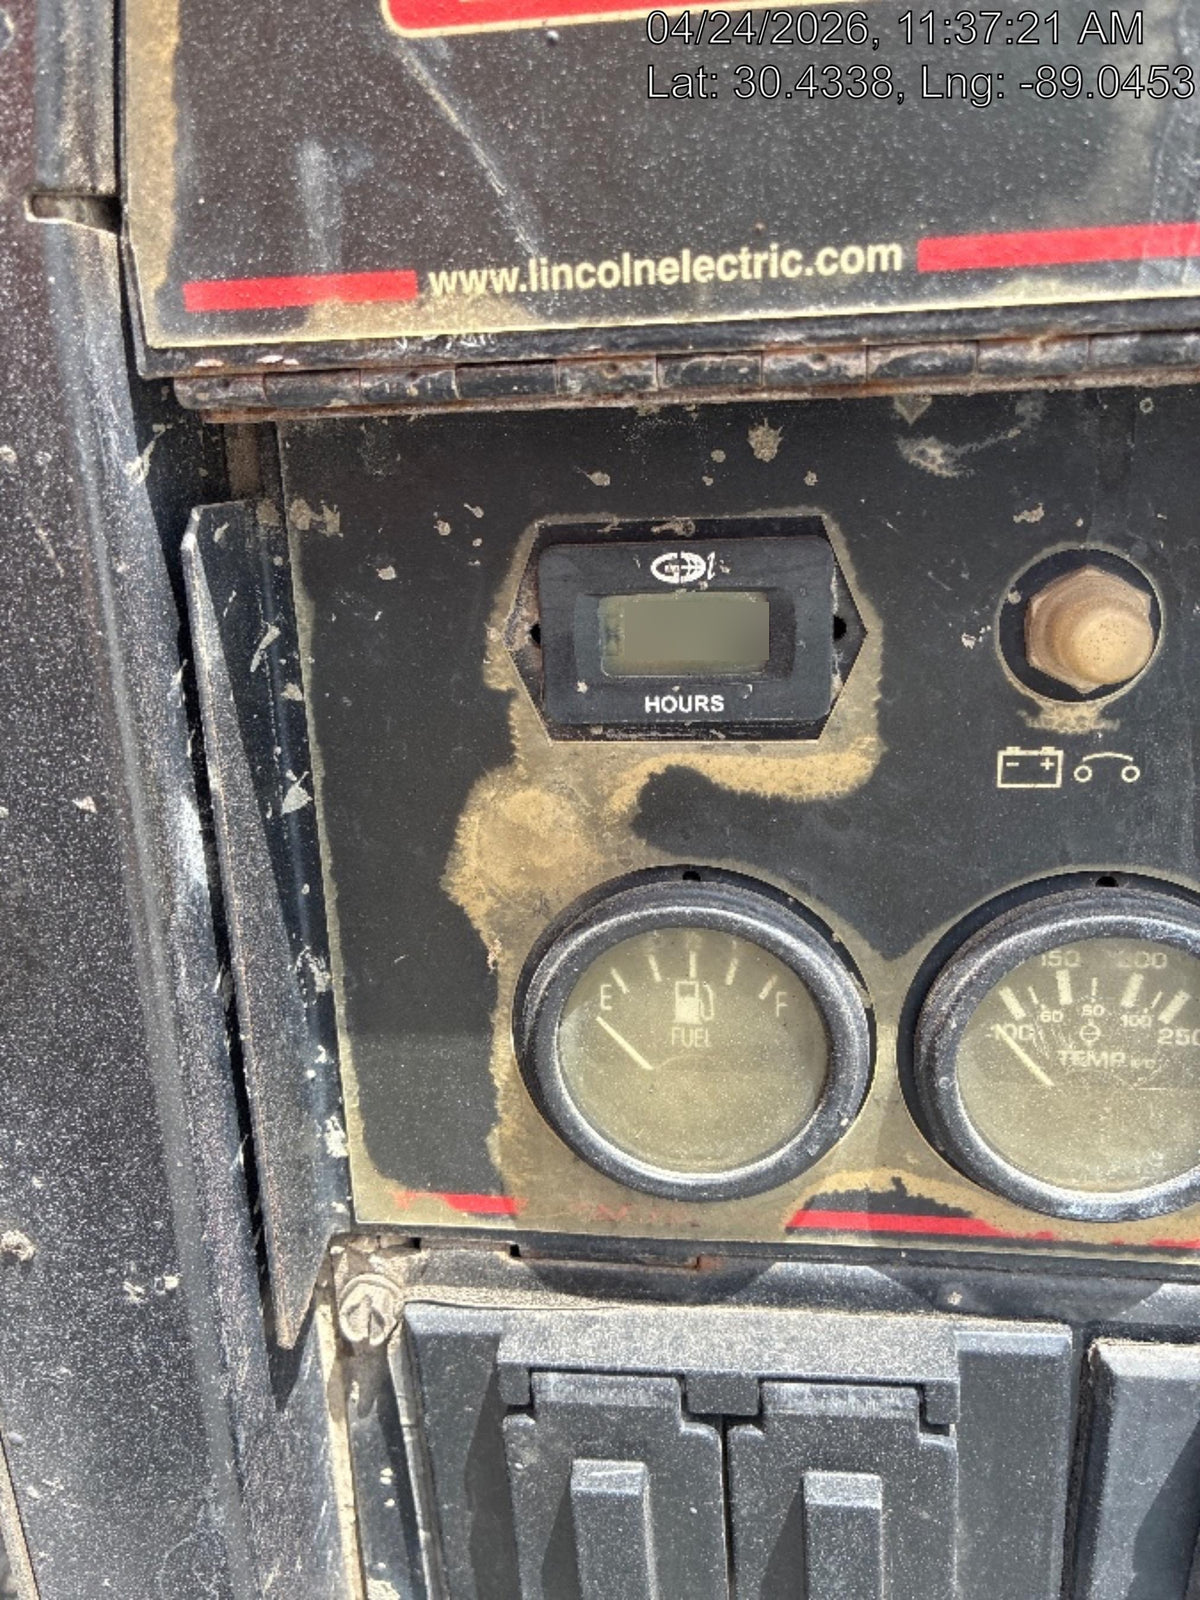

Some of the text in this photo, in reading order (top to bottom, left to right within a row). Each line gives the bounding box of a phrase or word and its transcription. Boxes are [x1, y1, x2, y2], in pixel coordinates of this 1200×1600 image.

[428, 242, 903, 297] www.lincolnelectric.com
[644, 694, 725, 714] HOURS
[1040, 950, 1081, 968] 150
[600, 984, 613, 1011] E
[775, 991, 788, 1017] F
[671, 1028, 712, 1048] FUEL
[1057, 1050, 1126, 1068] TEMP
